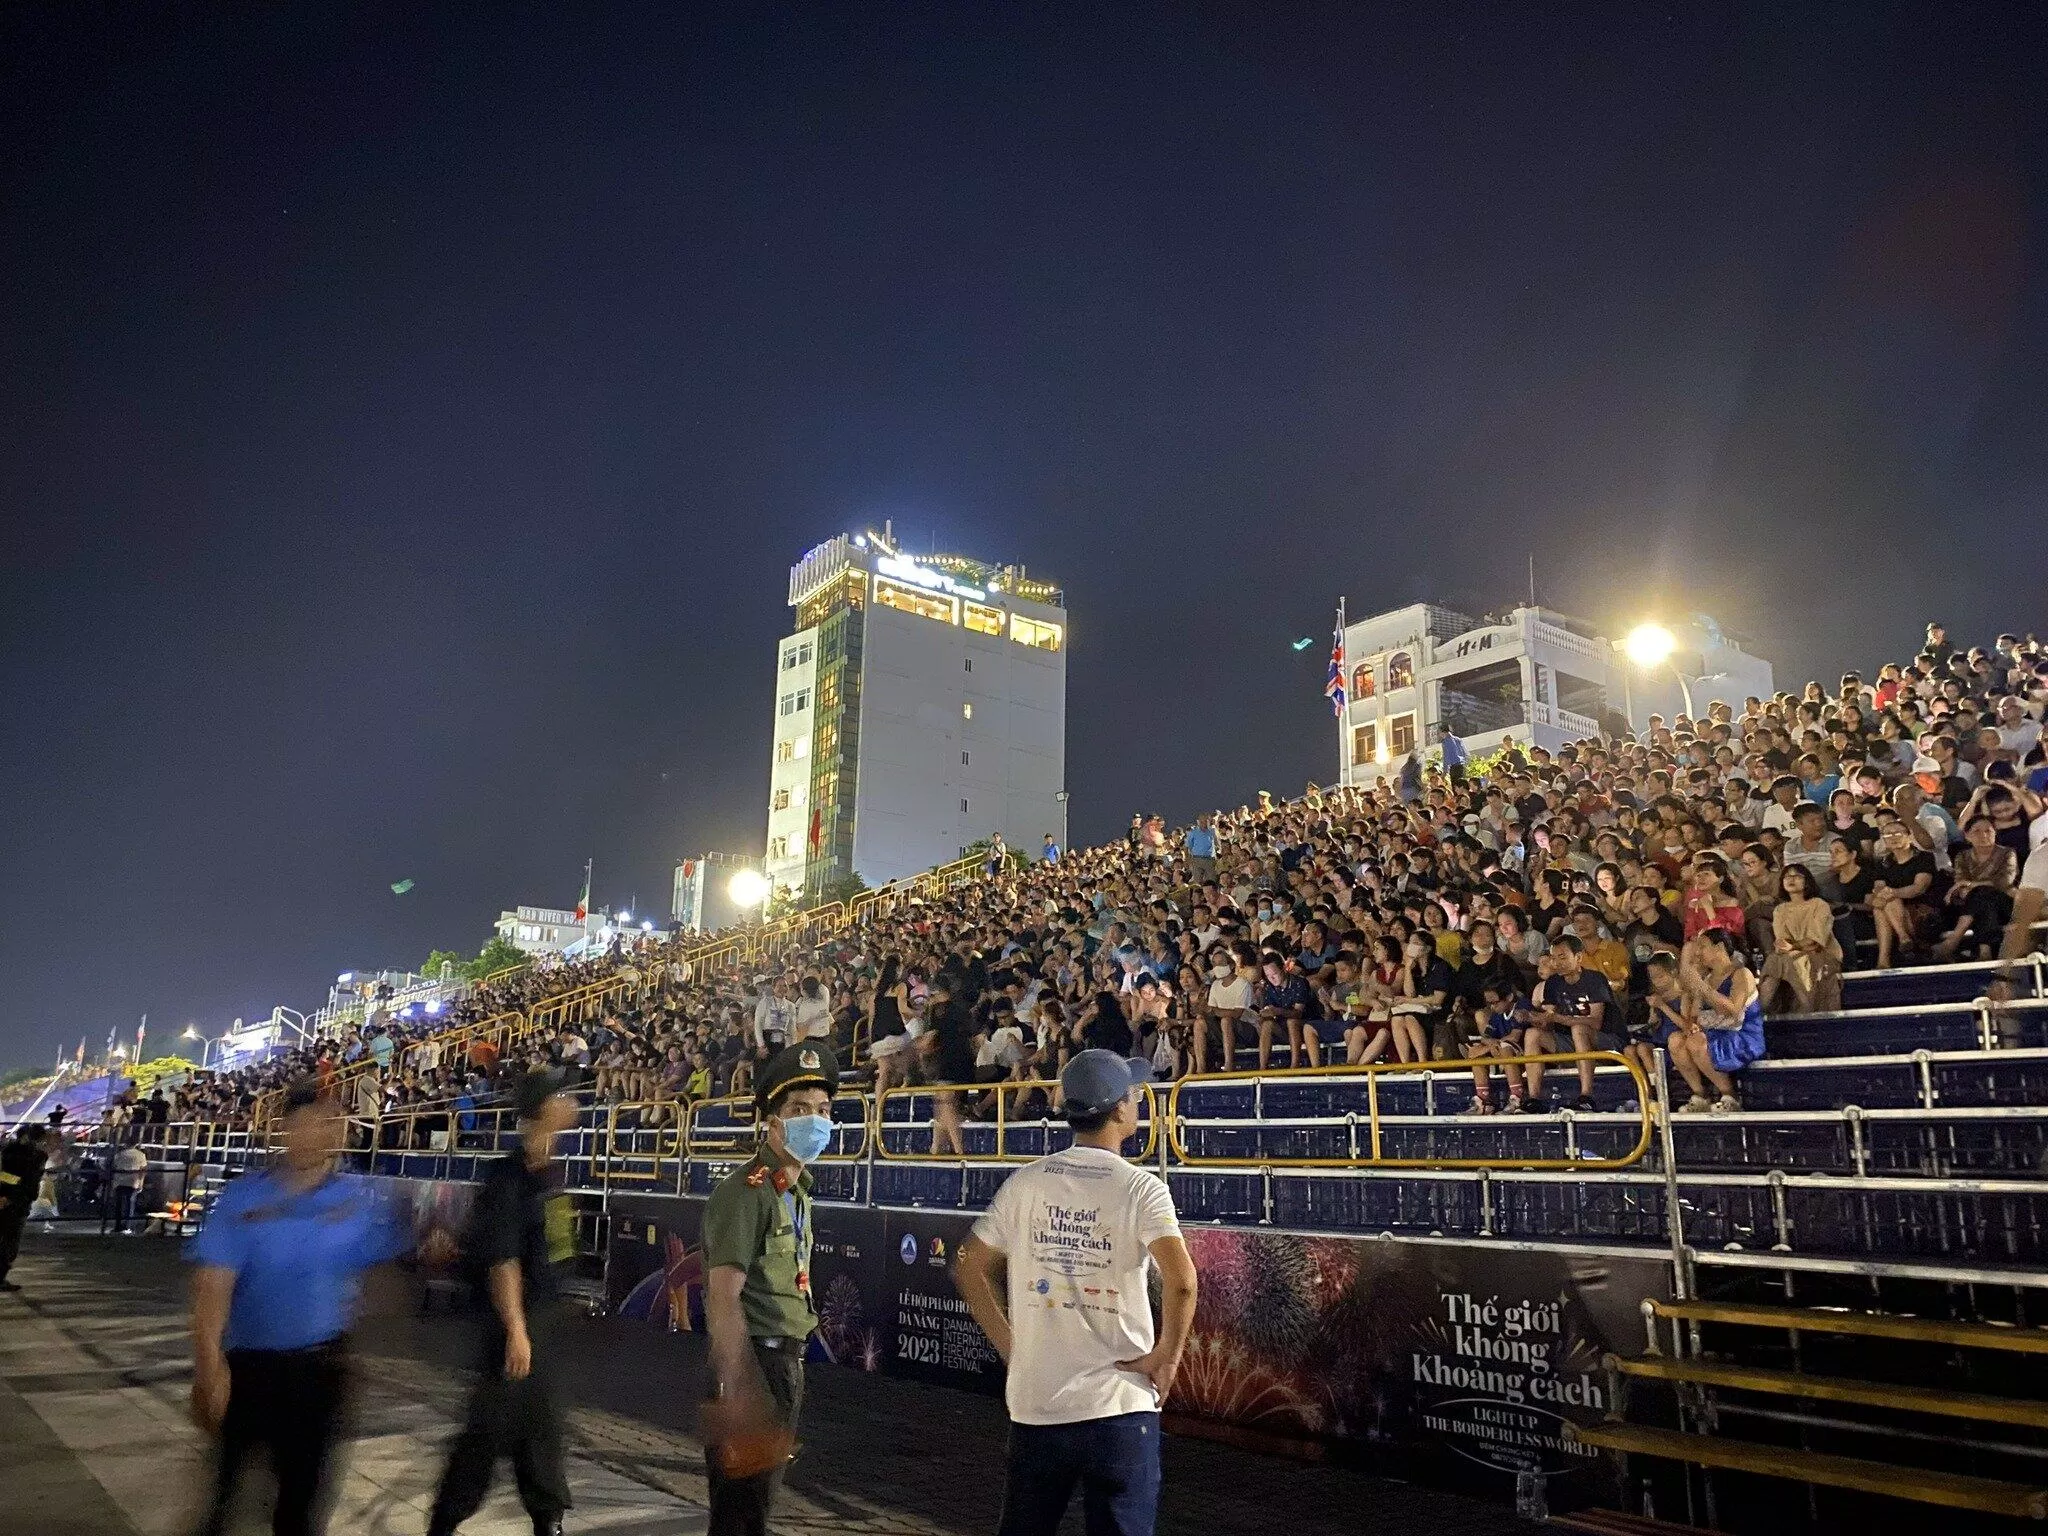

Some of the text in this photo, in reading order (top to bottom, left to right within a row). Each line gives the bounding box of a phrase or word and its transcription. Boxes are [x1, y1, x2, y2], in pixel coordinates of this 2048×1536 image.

[1050, 1218, 1091, 1237] không
[1081, 1237, 1112, 1251] cách
[1441, 1293, 1561, 1338] Thế giới
[898, 1333, 940, 1364] 2023
[942, 1342, 997, 1363] FIREWORKS
[1455, 1325, 1550, 1374] không
[942, 1355, 984, 1374] FESTIVAL
[1412, 1353, 1604, 1409] Khoảng cách
[1473, 1406, 1539, 1429] LIGHT UP
[1422, 1415, 1451, 1432] THE
[1452, 1419, 1543, 1448] BORDERLESS
[1542, 1435, 1599, 1459] WORLD
